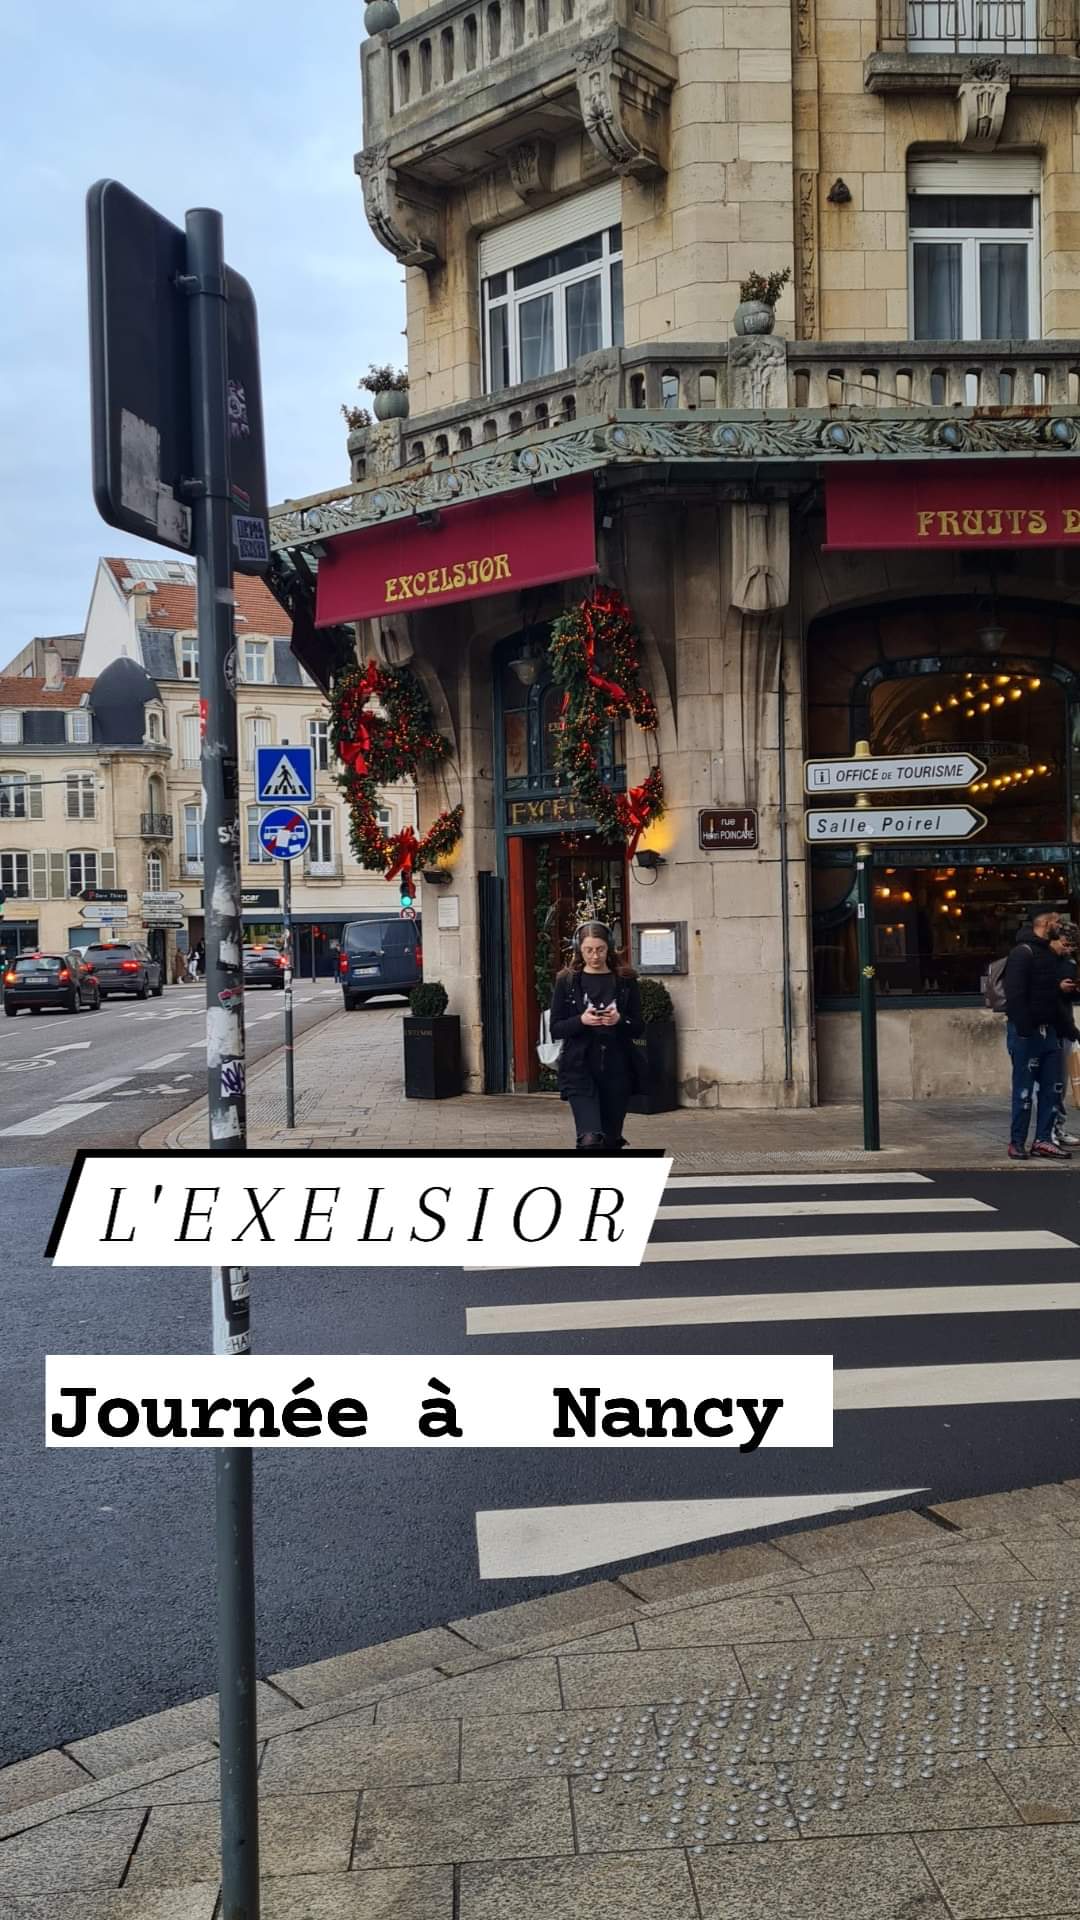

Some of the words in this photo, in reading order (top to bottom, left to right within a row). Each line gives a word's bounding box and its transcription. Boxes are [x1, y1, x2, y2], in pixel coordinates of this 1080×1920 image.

[916, 509, 1048, 536] FRUITS
[384, 553, 512, 602] EXCELSIOR
[835, 768, 879, 783] OFFICE
[897, 764, 964, 779] TOURISME
[721, 818, 736, 826] rue
[816, 818, 867, 834] Salle
[882, 815, 941, 832] Poirel
